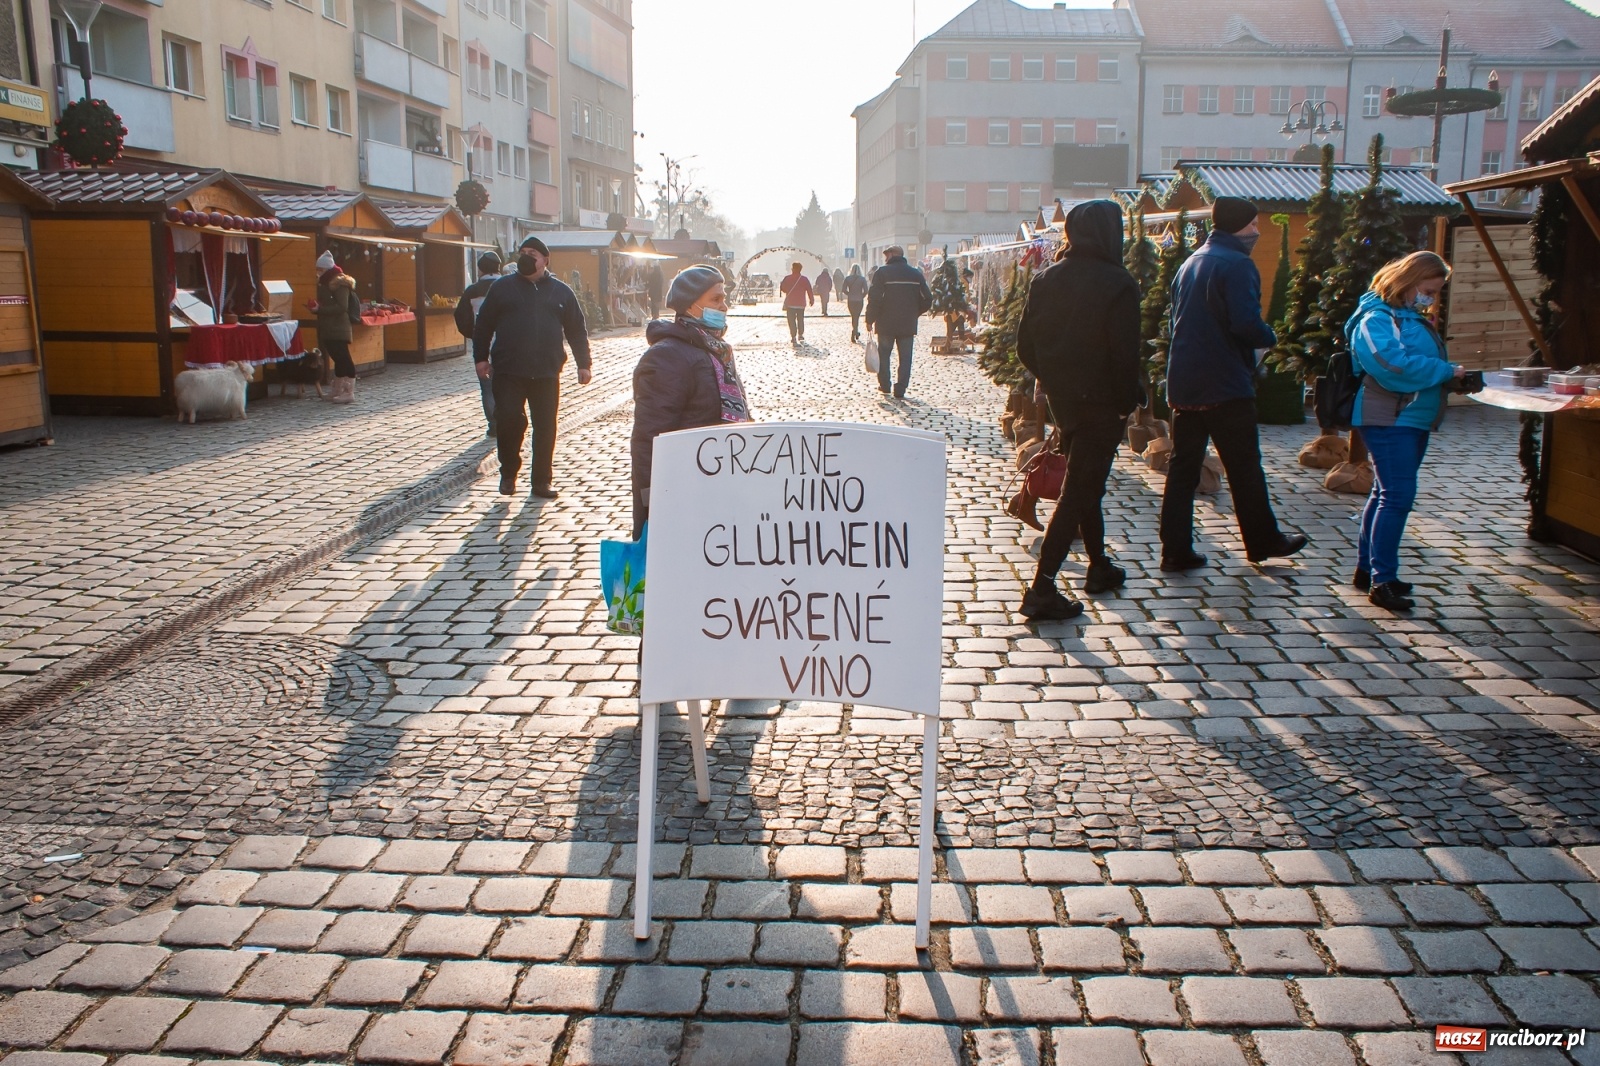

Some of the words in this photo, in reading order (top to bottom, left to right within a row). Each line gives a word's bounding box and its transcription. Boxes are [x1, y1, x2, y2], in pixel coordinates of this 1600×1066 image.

[10, 92, 42, 109] FINANSE
[696, 432, 842, 476] GRZANE
[784, 477, 864, 513] WINO
[703, 513, 909, 568] GLÜHWEIN
[702, 578, 891, 643] SVAŘENÉ
[779, 643, 871, 698] VÍNO
